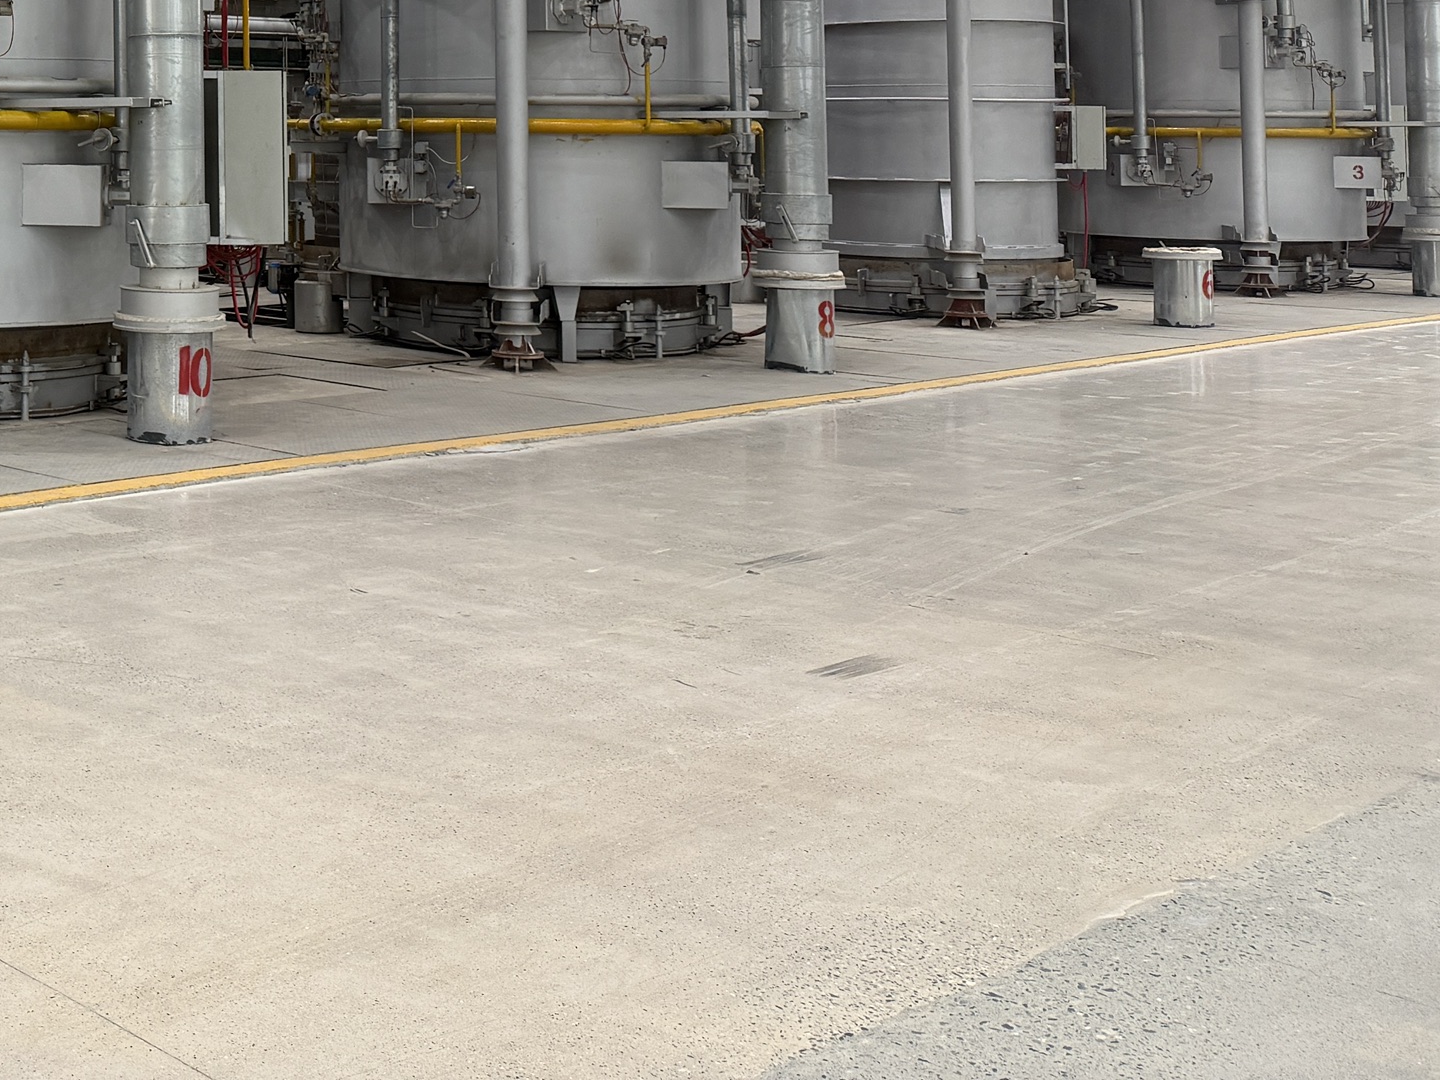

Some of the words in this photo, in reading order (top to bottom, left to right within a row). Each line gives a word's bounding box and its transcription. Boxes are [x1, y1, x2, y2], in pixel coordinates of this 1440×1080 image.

[1353, 165, 1364, 179] 3
[818, 301, 834, 338] 8
[179, 345, 211, 397] 10
